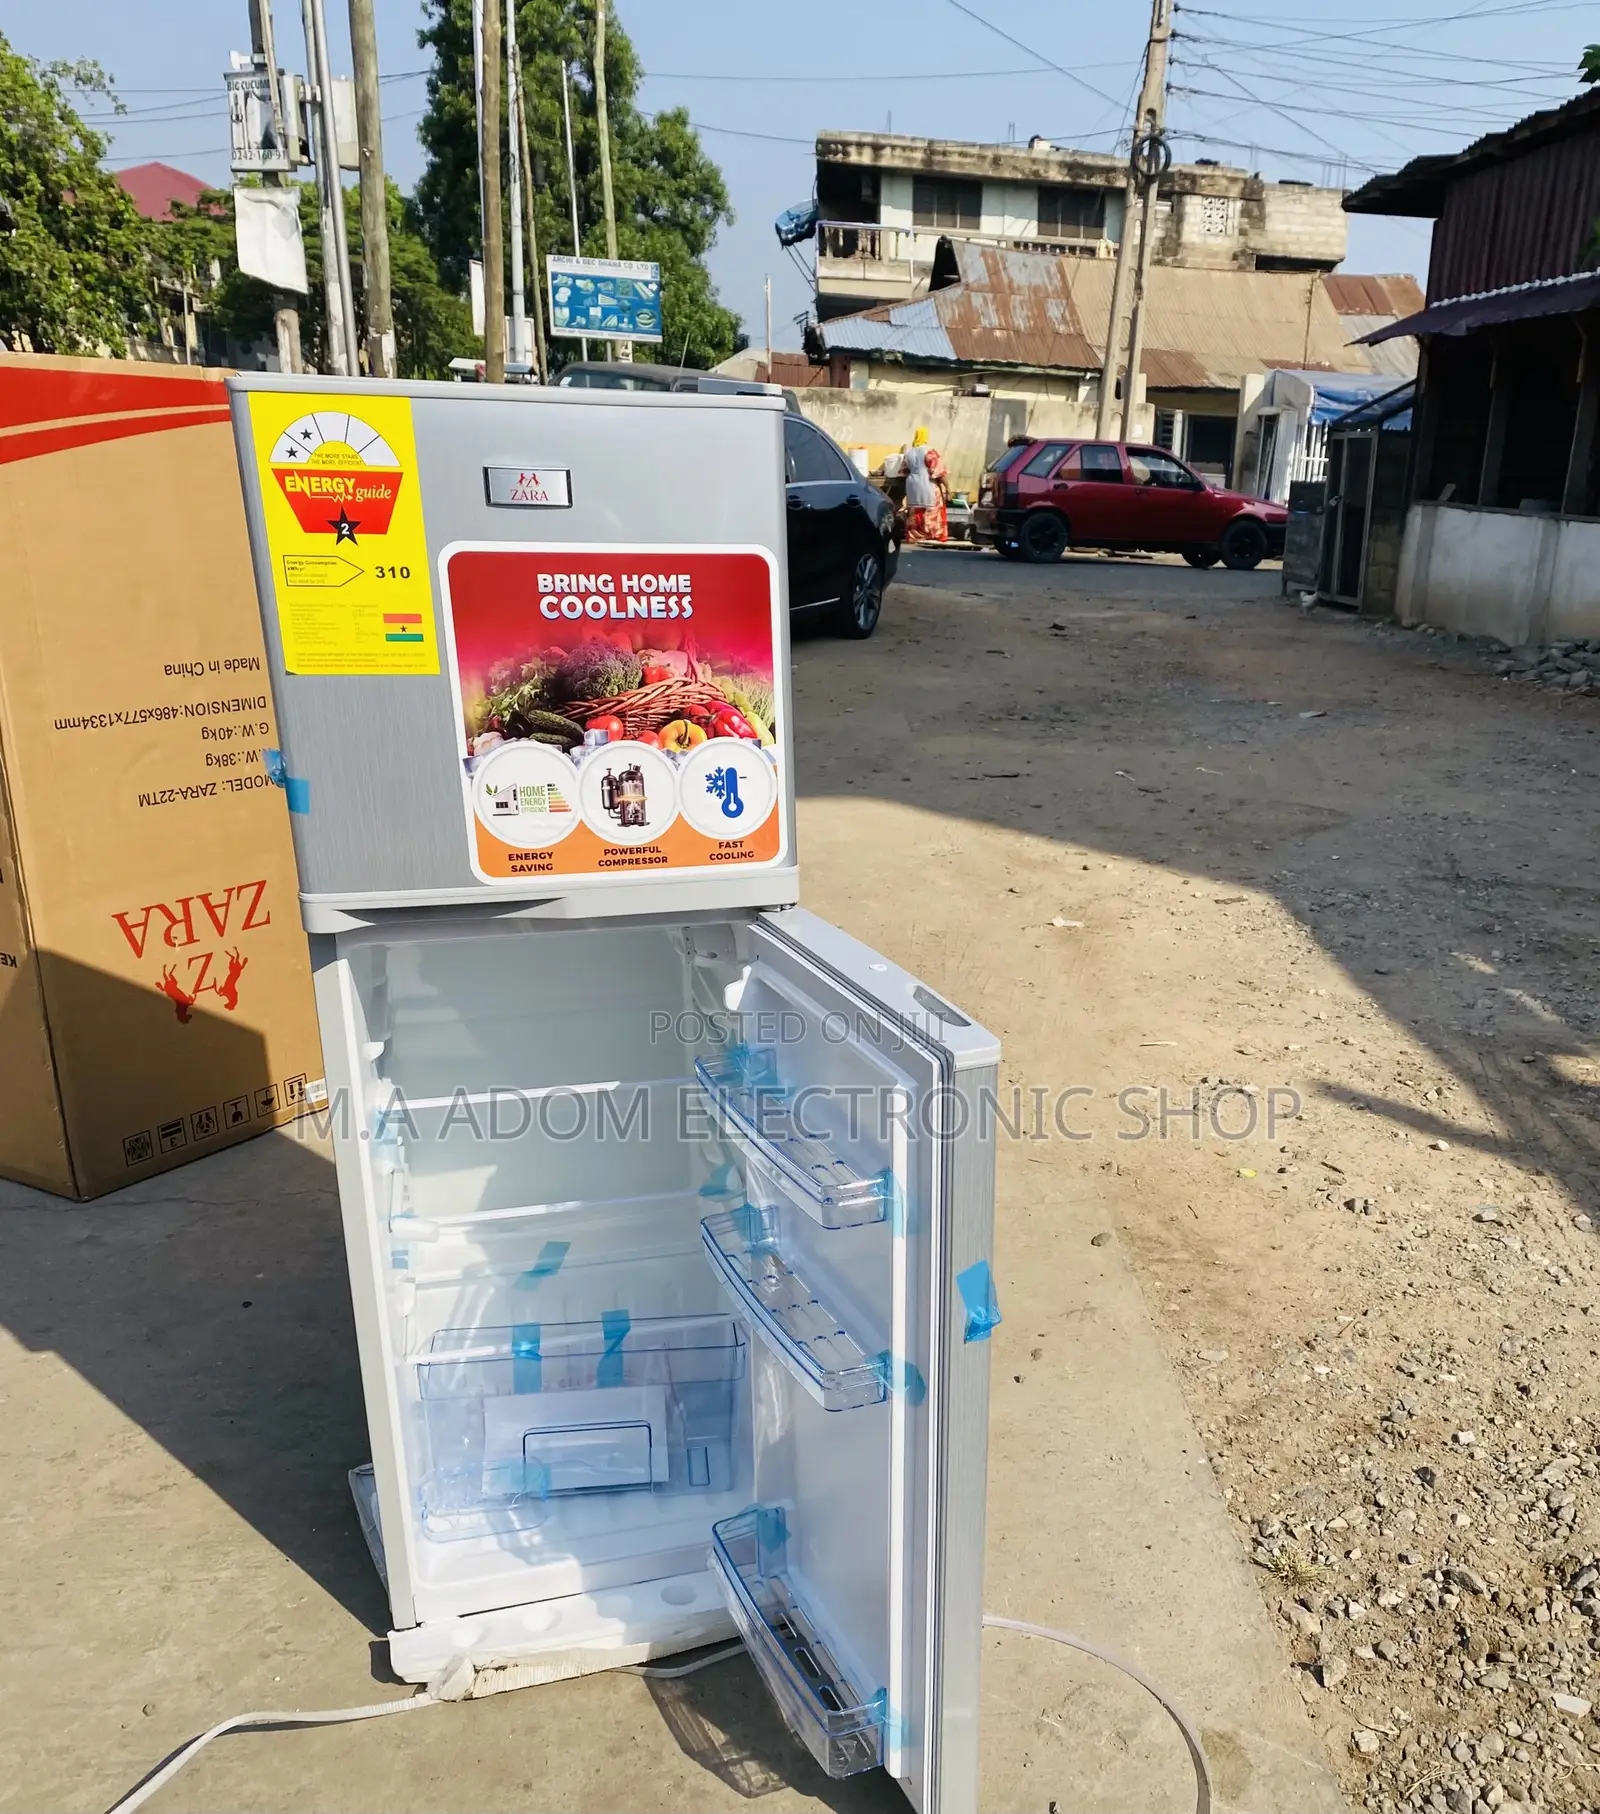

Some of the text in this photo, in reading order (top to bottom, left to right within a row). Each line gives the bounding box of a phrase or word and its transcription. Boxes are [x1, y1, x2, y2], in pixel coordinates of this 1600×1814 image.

[227, 80, 240, 91] BIG
[284, 470, 392, 501] ENERGY guide
[510, 488, 549, 502] ZARA
[340, 523, 350, 535] 2
[375, 566, 411, 579] 310
[537, 573, 692, 594] BRING HOME
[539, 594, 694, 620] COOLNESS
[164, 657, 260, 678] Made in China
[205, 748, 270, 768] .W.:38kg
[138, 782, 217, 808] ZARA-22TM
[519, 784, 546, 798] HOME
[519, 798, 547, 807] ENERGY
[603, 845, 662, 857] POWERFUL
[718, 840, 745, 849] FAST
[508, 850, 554, 862] ENERGY
[598, 855, 669, 867] COMPRESSOR
[709, 850, 755, 861] COOLING
[510, 862, 554, 873] SAVING
[111, 879, 272, 959] ZARA
